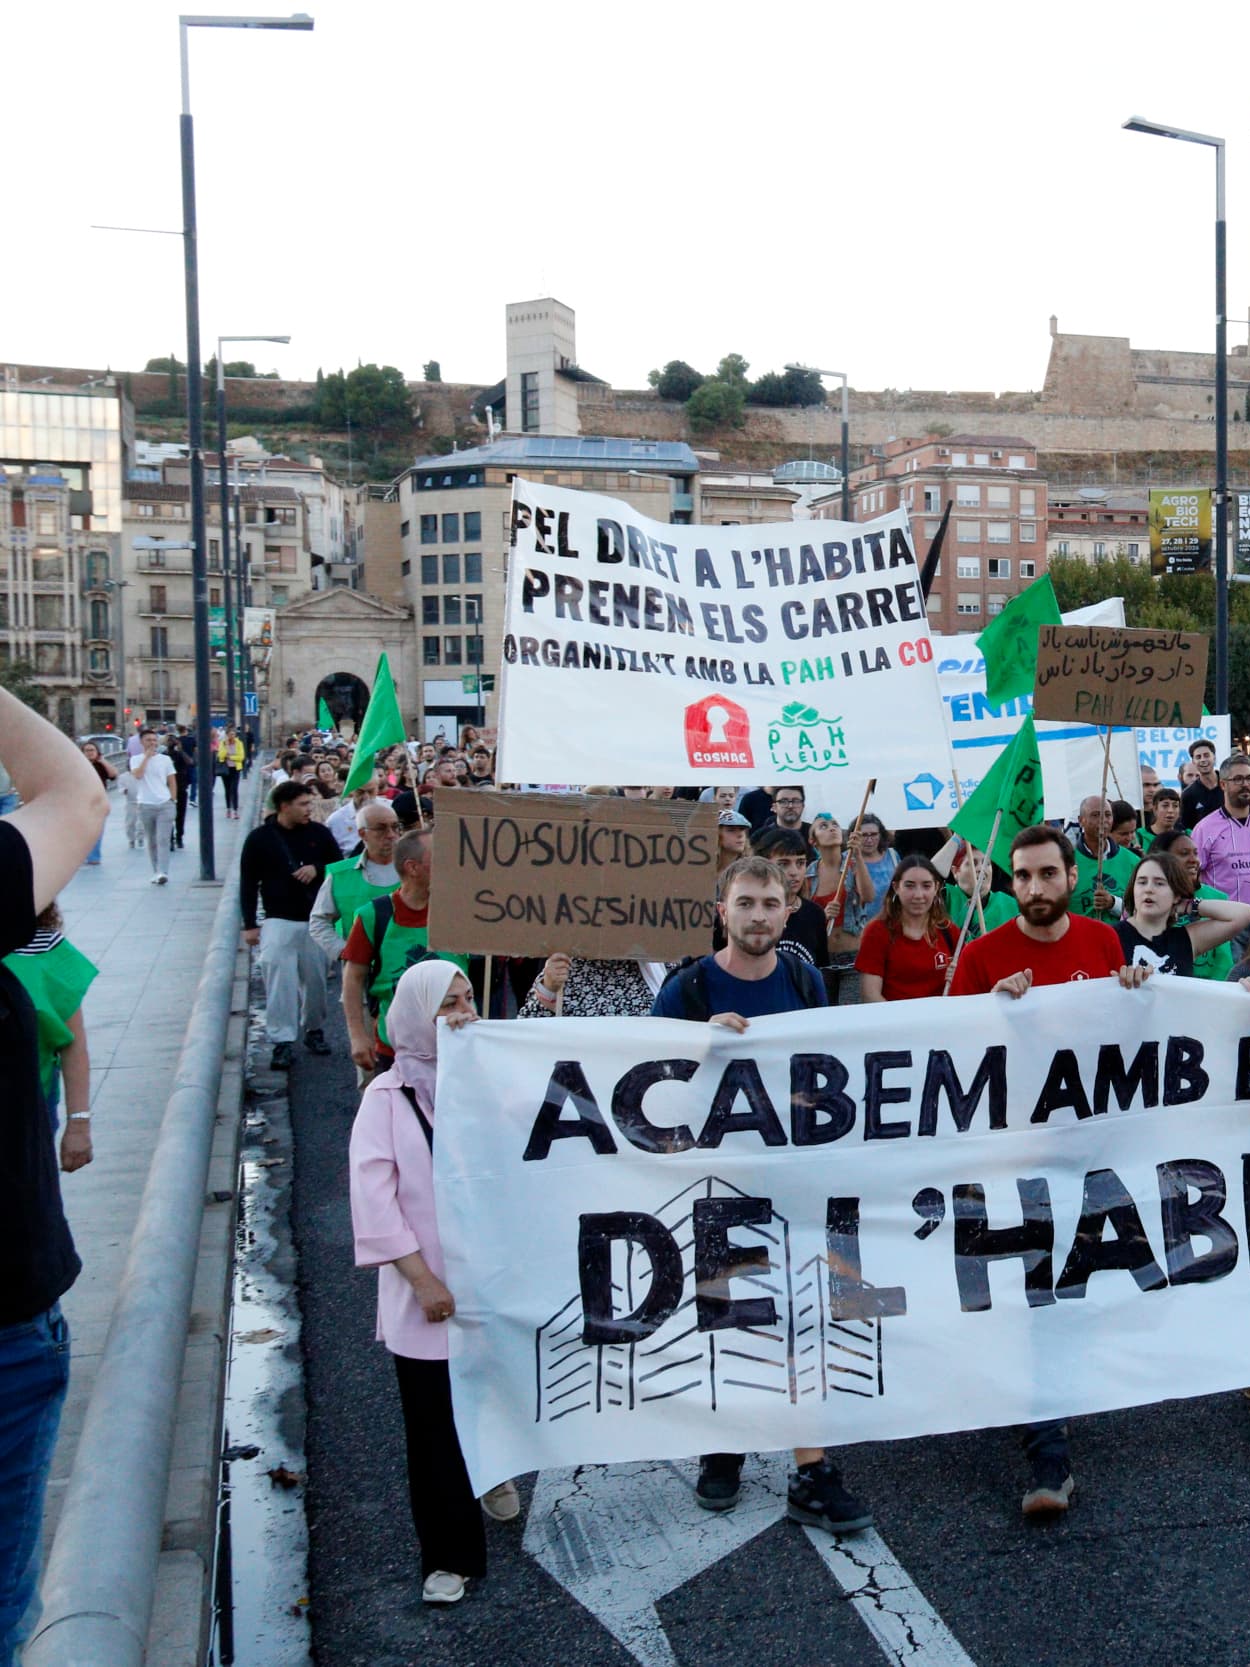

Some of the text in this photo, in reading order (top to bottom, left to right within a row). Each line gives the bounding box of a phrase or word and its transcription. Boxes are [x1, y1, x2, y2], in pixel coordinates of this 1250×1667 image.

[1161, 495, 1199, 506] AGRO
[1164, 516, 1199, 527] TECH
[1176, 506, 1199, 517] BIO
[511, 500, 579, 559] PEL
[597, 518, 681, 583] DRET
[695, 547, 721, 589] A
[1173, 537, 1183, 545] 28
[1189, 537, 1199, 545] 29
[522, 568, 928, 645] PRENEM ELS CARRE
[685, 656, 737, 685] AMB
[743, 660, 775, 686] LA
[781, 655, 834, 686] PAH
[843, 652, 852, 677] I
[861, 645, 892, 673] LA
[898, 637, 934, 667] CO
[1075, 690, 1114, 717] PAH
[768, 725, 846, 750] PAH
[1150, 729, 1169, 742] EL
[693, 751, 748, 764] COSHAC
[771, 748, 847, 764] LLEIDA
[473, 889, 546, 925] SON
[522, 1045, 1008, 1161] ACABEM
[1030, 1035, 1210, 1125] AMB
